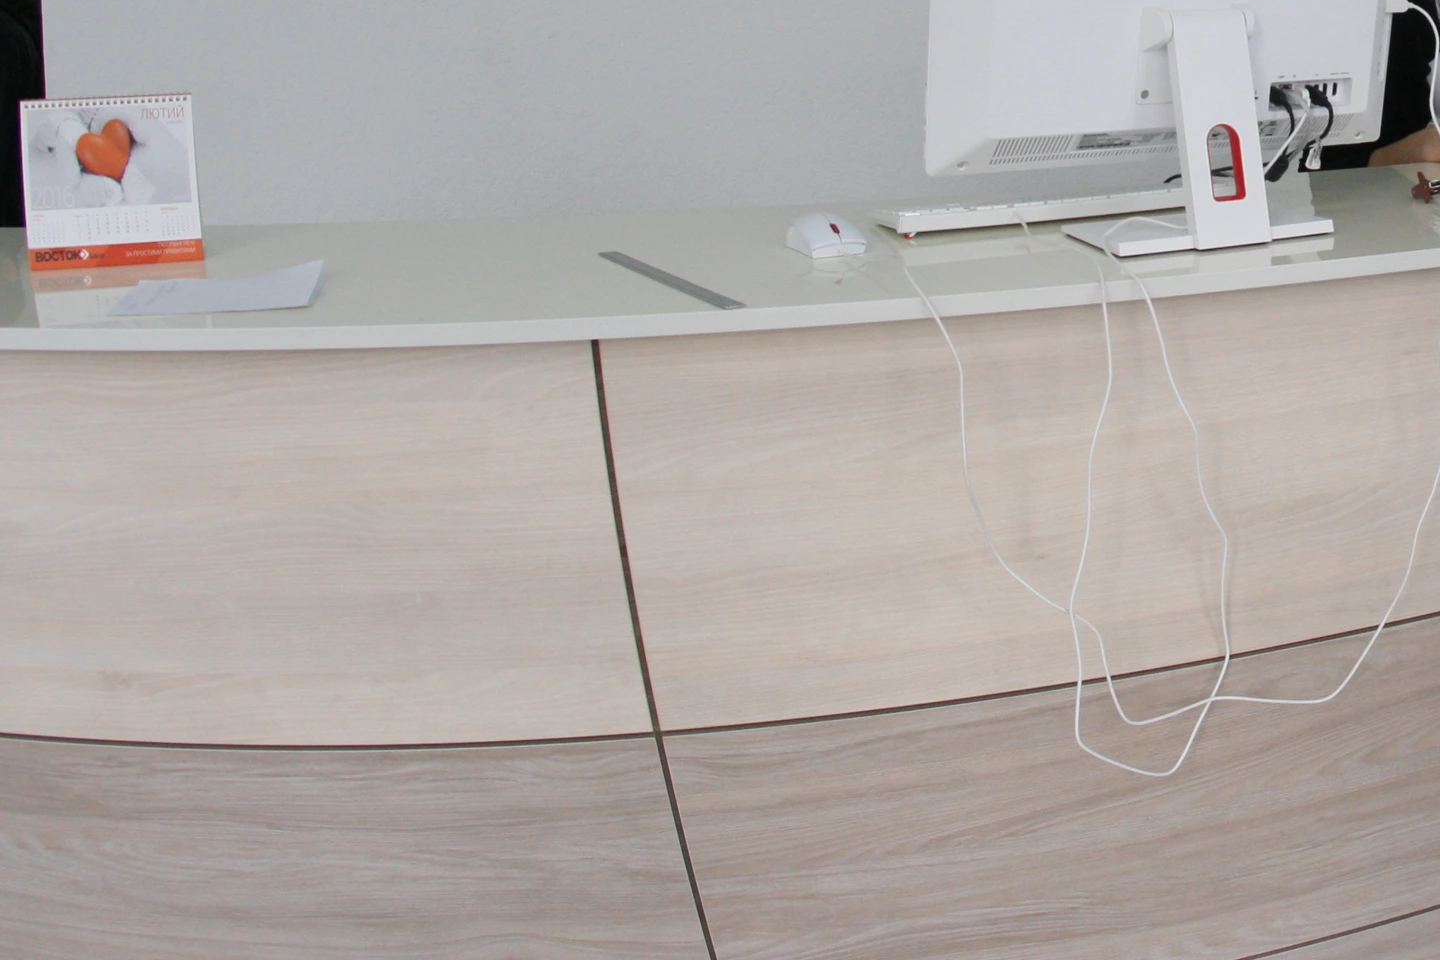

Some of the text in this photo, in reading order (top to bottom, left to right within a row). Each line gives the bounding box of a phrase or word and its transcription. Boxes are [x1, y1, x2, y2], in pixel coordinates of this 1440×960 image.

[140, 104, 185, 120] ЛЮТИЙ
[32, 185, 75, 210] 2016
[35, 250, 82, 263] ВОСТОК
